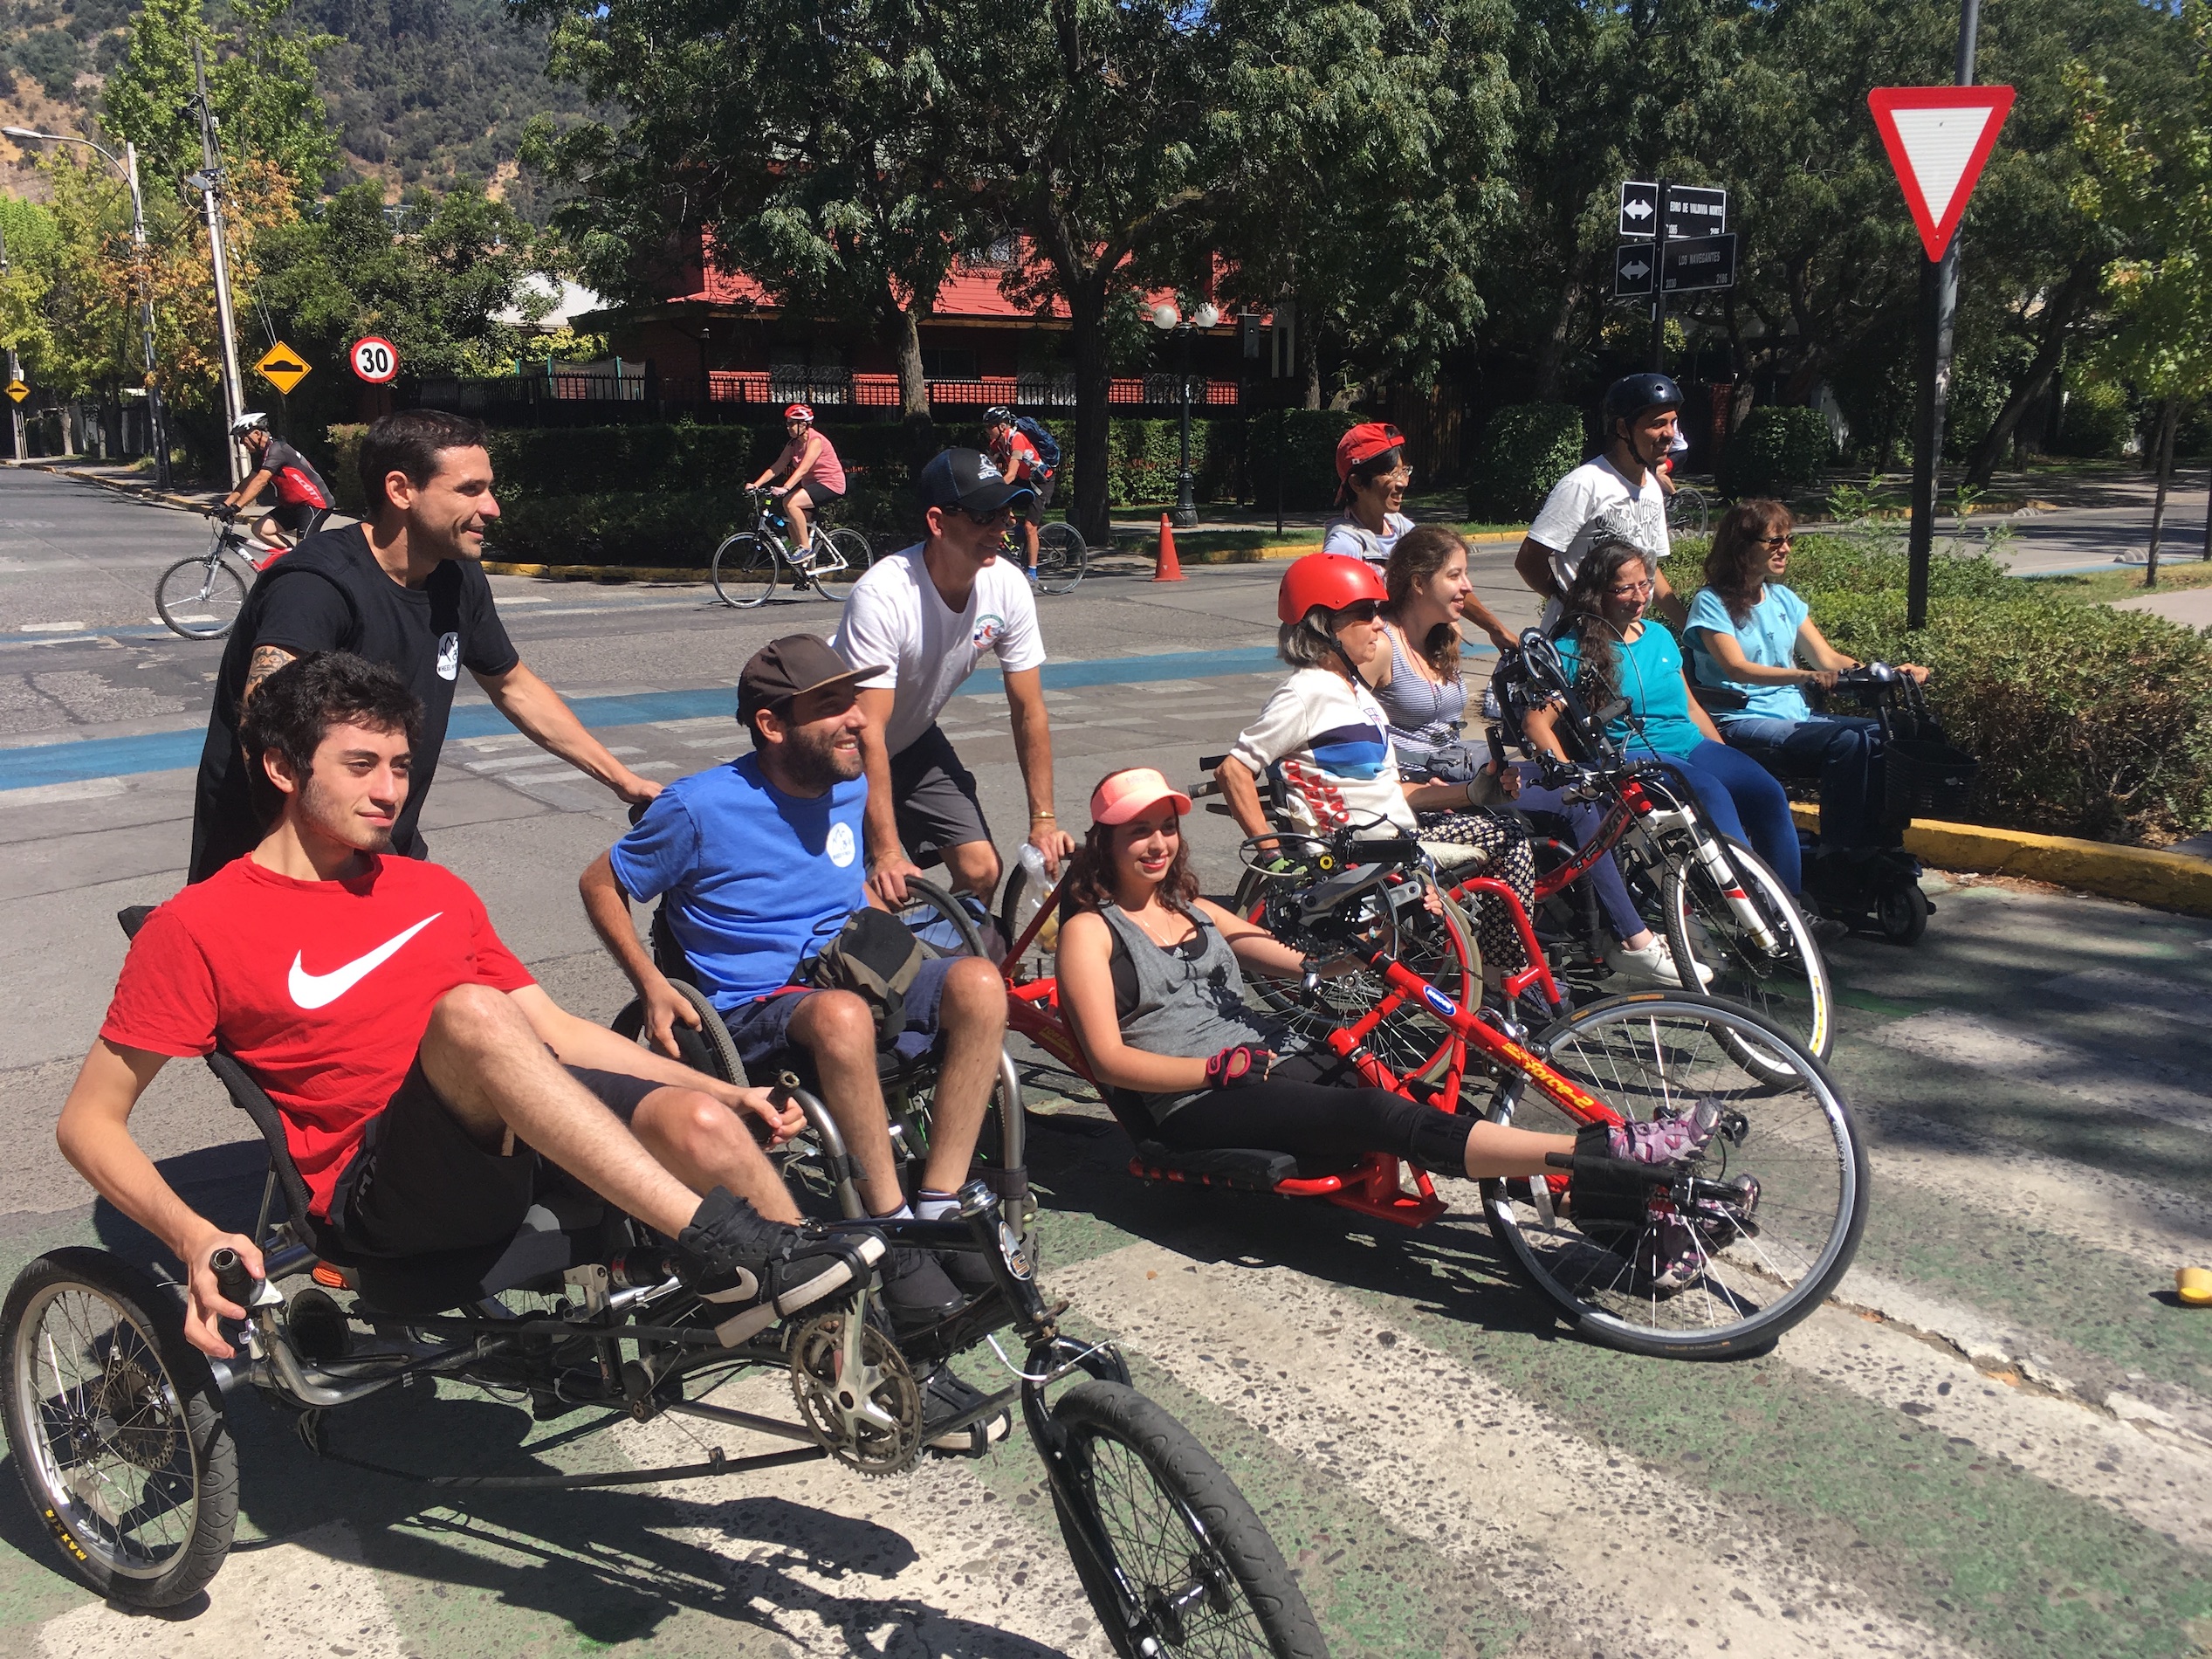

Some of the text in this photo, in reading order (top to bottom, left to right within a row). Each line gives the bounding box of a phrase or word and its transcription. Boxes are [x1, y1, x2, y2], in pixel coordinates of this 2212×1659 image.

[1669, 201, 1723, 216] EDRO DE VALDIVIA NORTE
[1679, 251, 1721, 265] LOS NAVEGANTES
[361, 348, 388, 373] 30
[291, 473, 322, 502] SCOTT
[45, 1509, 87, 1560] MAXXIS
